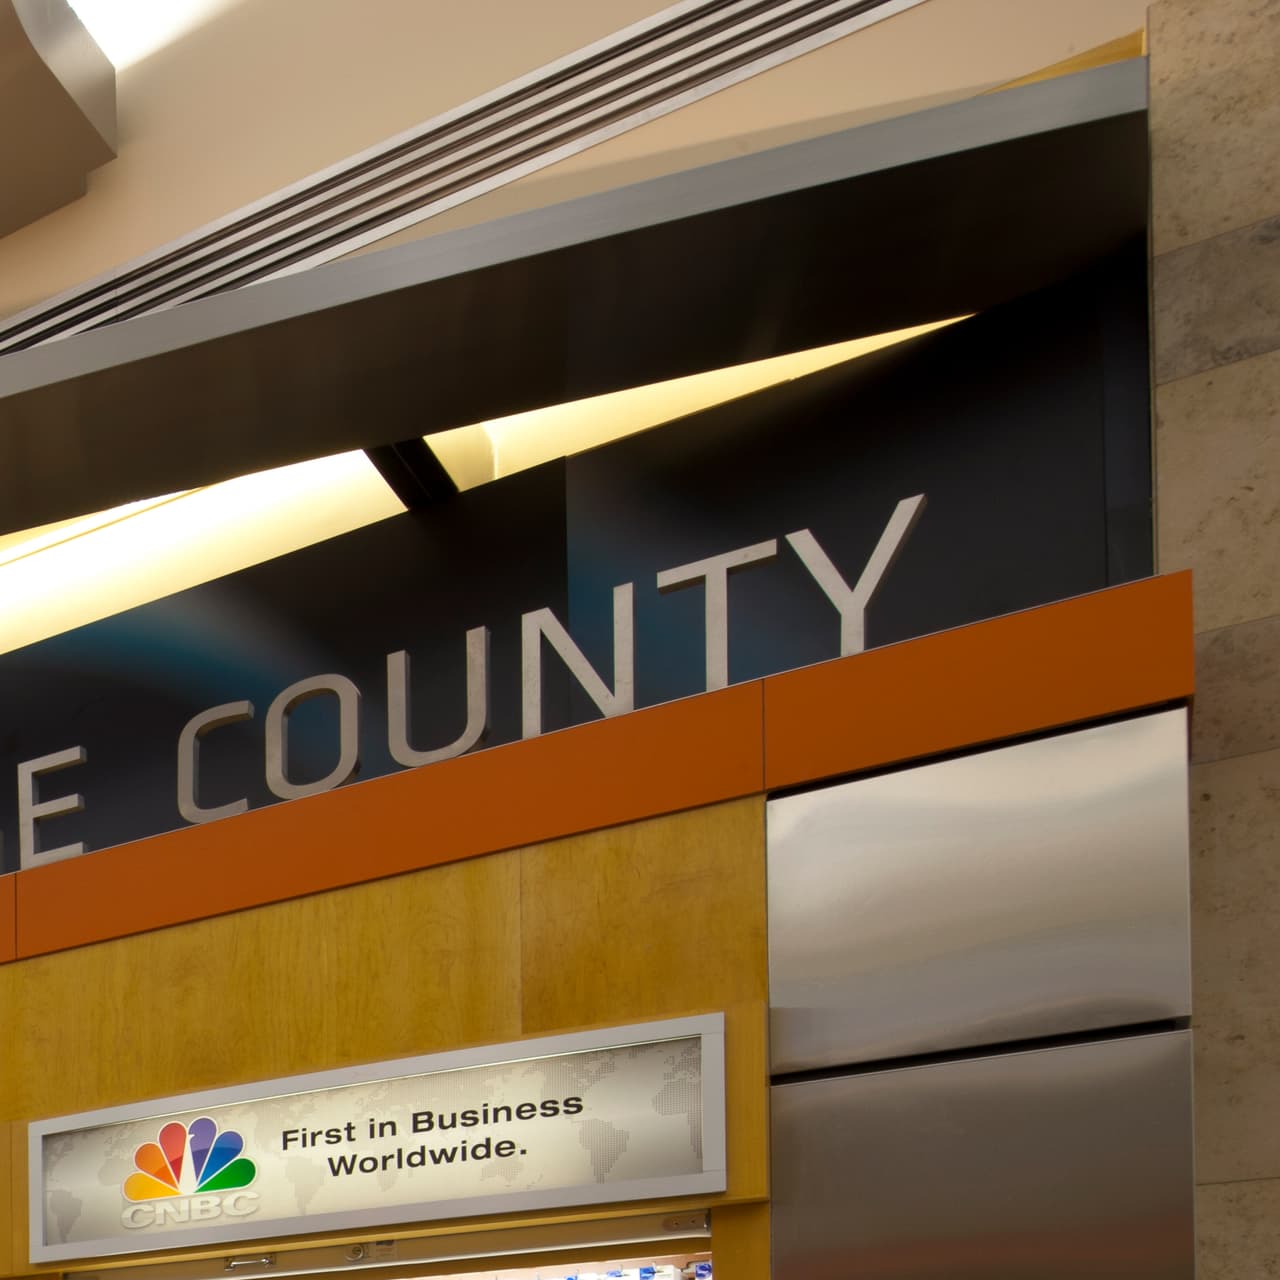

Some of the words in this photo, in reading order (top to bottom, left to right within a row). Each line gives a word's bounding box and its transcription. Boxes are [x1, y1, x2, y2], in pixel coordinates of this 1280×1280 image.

[176, 493, 926, 825] COUNTY
[282, 1121, 356, 1151] First
[369, 1118, 397, 1139] in
[412, 1095, 584, 1134] Business
[328, 1136, 528, 1177] Worldwide.
[121, 1190, 261, 1229] CNBC
